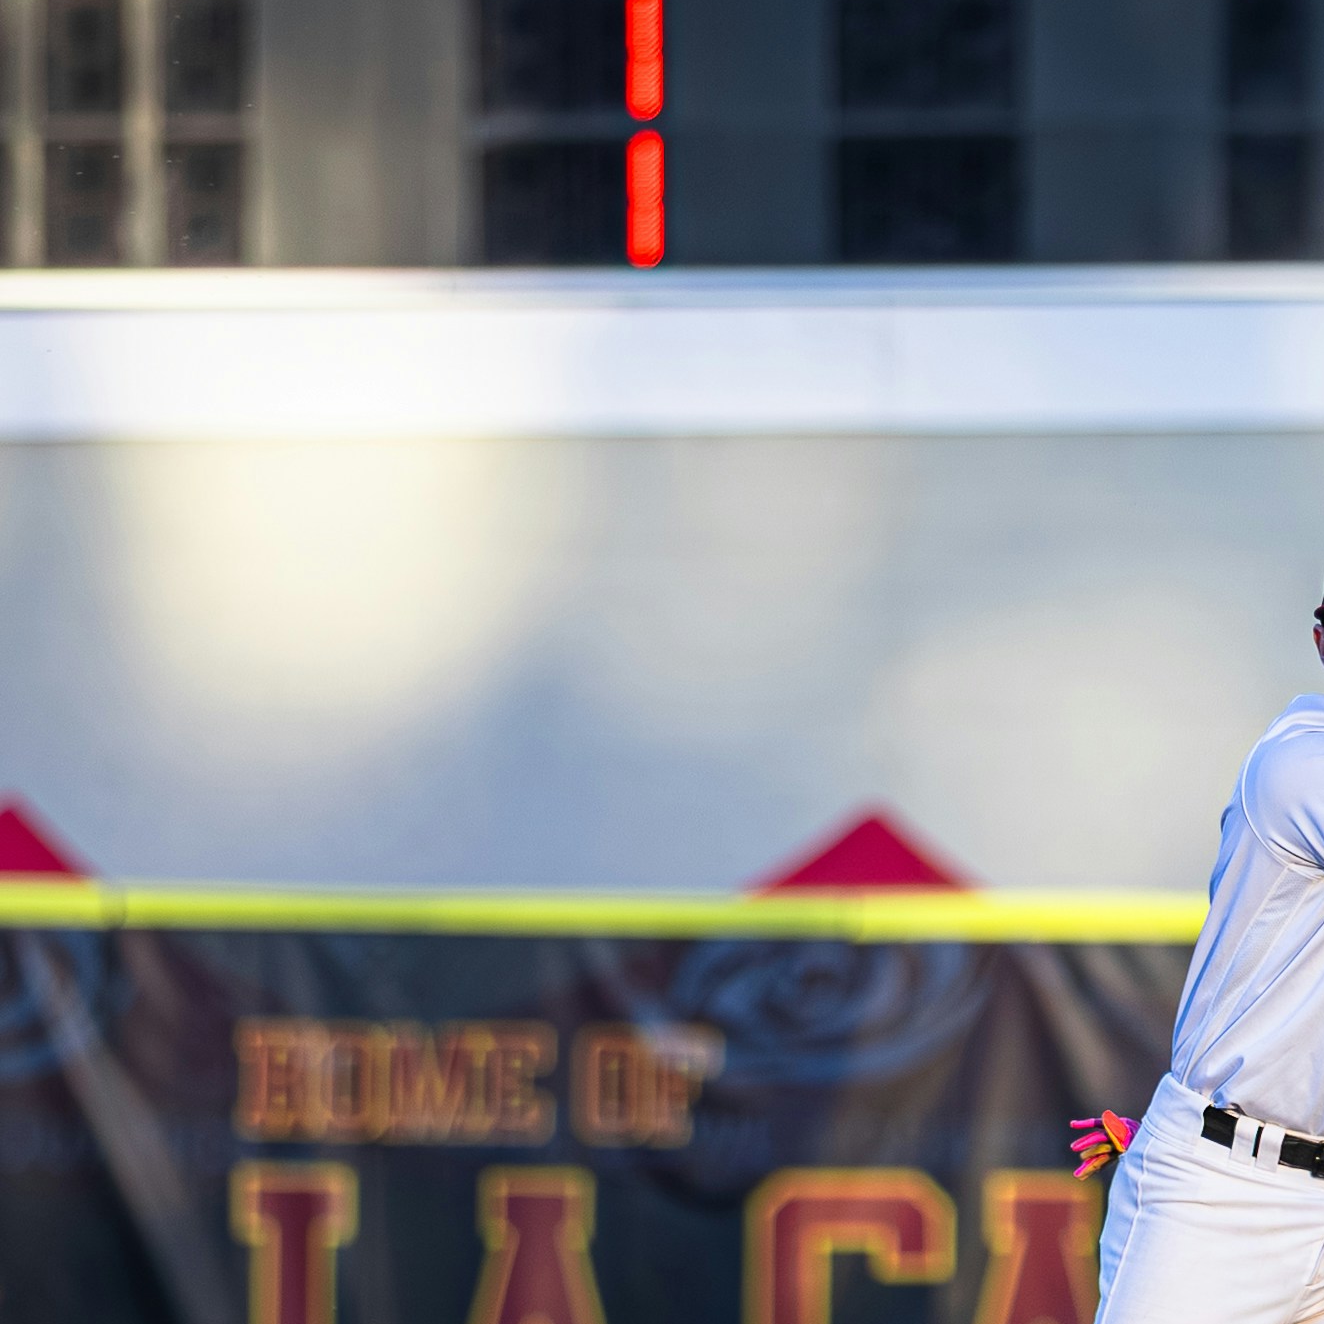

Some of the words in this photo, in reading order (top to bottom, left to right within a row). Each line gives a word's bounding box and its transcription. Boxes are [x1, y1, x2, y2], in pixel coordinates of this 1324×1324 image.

[626, 130, 665, 268] 1
[232, 1017, 558, 1146] HOME
[571, 1021, 726, 1149] OF
